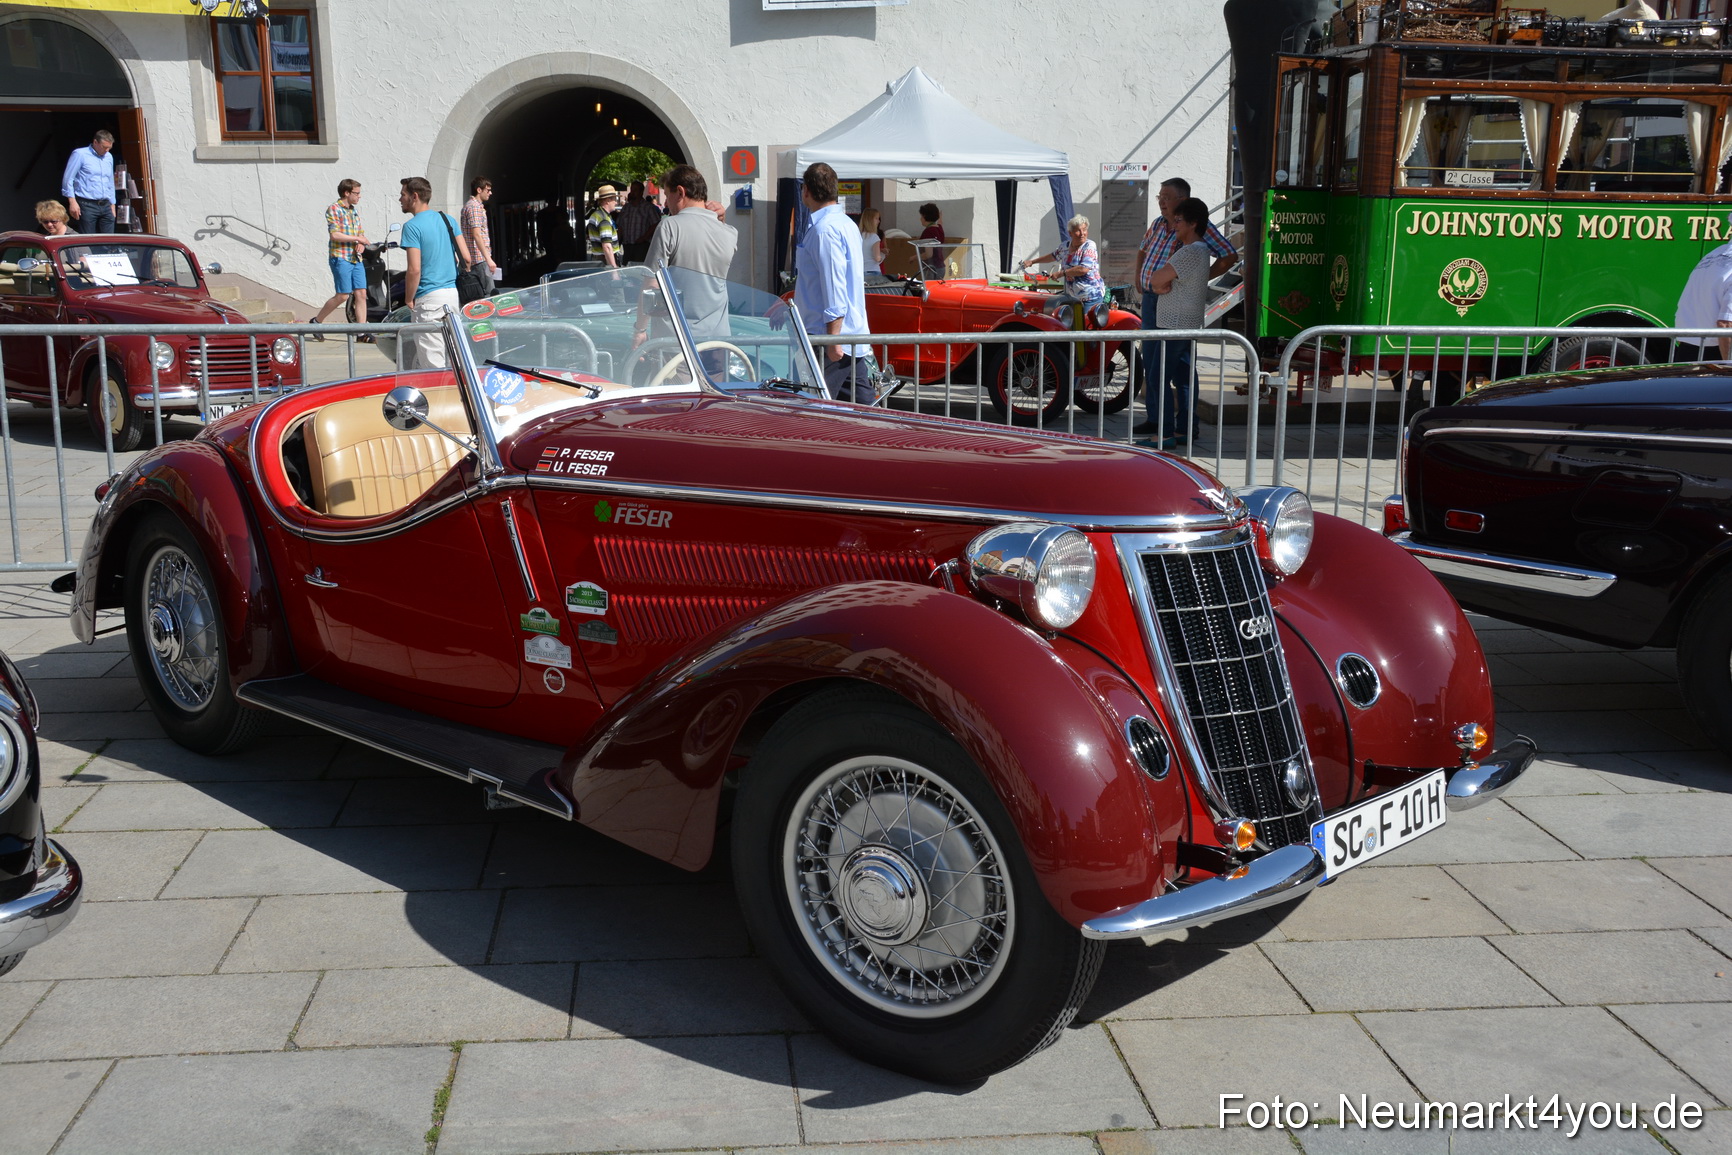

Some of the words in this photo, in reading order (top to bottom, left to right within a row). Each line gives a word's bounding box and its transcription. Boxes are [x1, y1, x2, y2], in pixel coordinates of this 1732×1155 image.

[1103, 164, 1141, 172] NEUMARKT
[1460, 173, 1492, 184] Classe
[1271, 211, 1326, 225] JOHNSTON'S
[1406, 210, 1563, 238] JOHNSTON'S
[1577, 214, 1674, 240] MOTOR
[1279, 232, 1314, 245] MOTOR
[1266, 252, 1326, 265] TRANSPORT
[560, 448, 571, 458] P.
[573, 449, 615, 462] FESER
[553, 461, 564, 473] U.
[567, 462, 608, 476] FESER
[613, 506, 673, 528] FESER
[1333, 814, 1364, 867] SC
[1379, 800, 1394, 847] F
[1400, 779, 1443, 838] 10H
